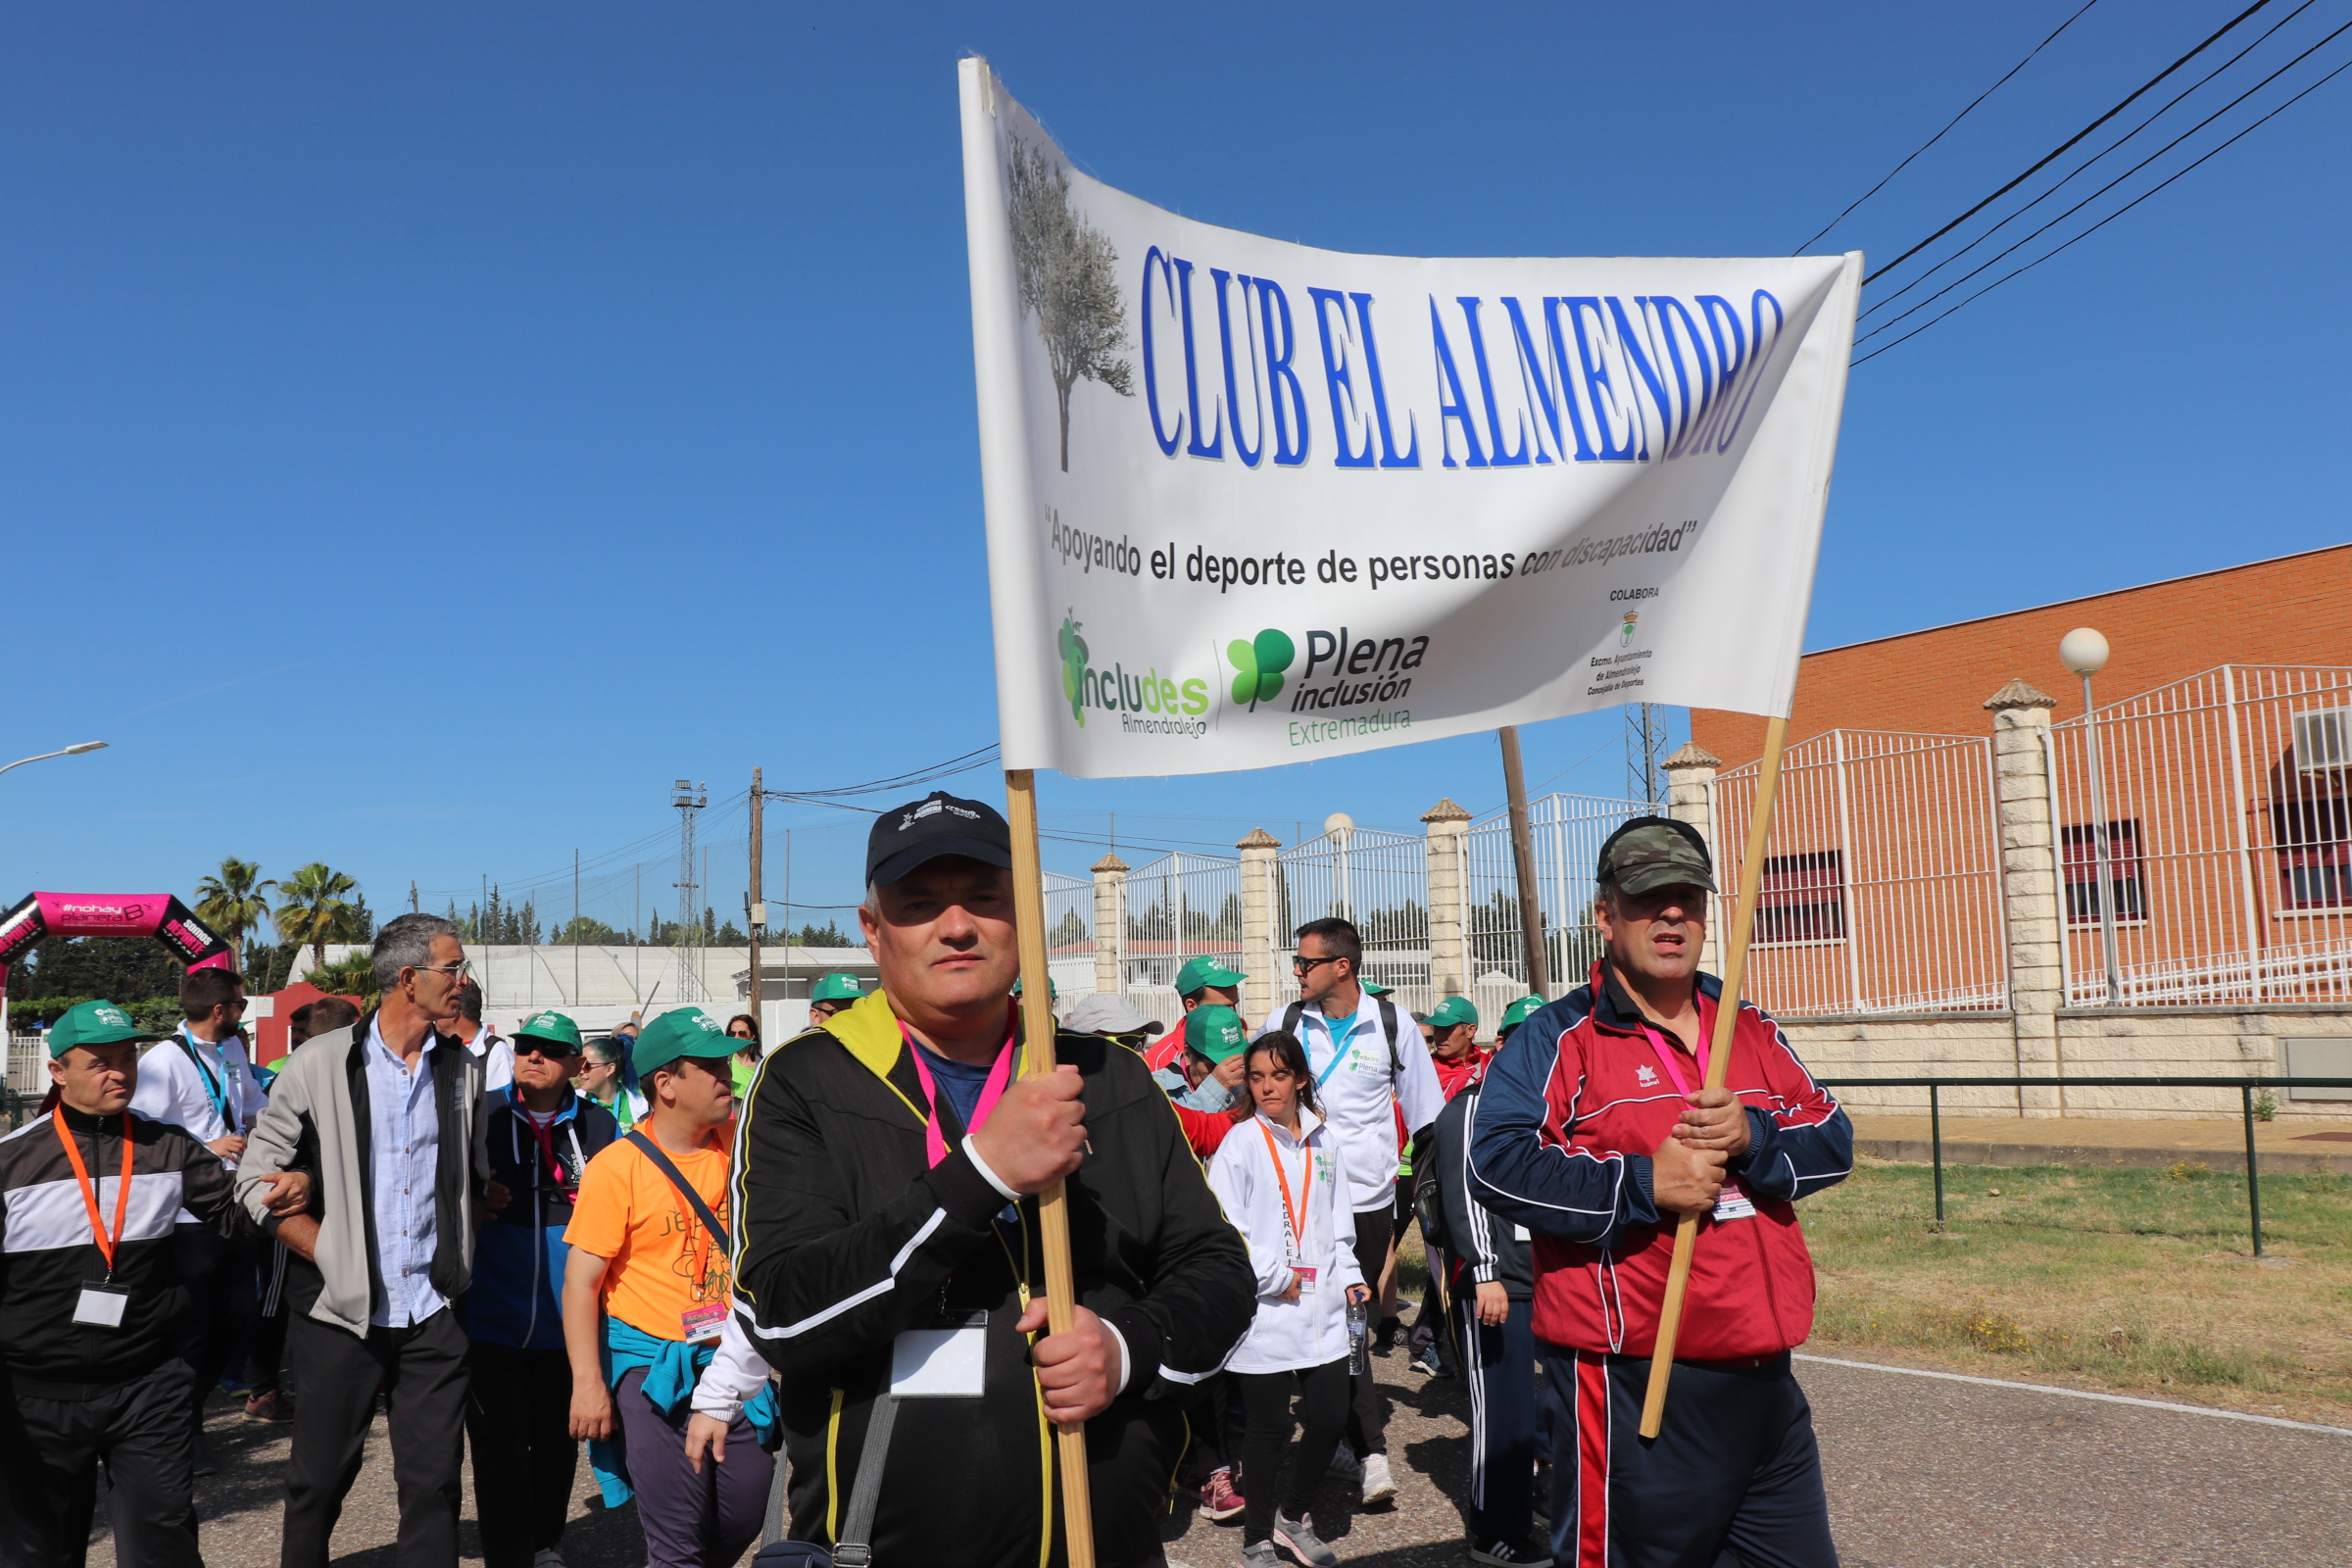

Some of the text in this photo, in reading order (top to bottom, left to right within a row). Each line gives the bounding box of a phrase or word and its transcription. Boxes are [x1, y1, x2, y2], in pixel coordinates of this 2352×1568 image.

[1142, 245, 1785, 470] CLUB EL ALMENDRO
[1151, 542, 1175, 580] el
[1186, 545, 1305, 594] deporte
[1317, 549, 1357, 584] de
[1368, 553, 1516, 591] personas
[1520, 549, 1563, 577] con
[1609, 587, 1660, 602] COLABORA
[1303, 626, 1430, 679] Plena
[1591, 649, 1652, 667] Excmo. Ayuntamiento
[1076, 654, 1209, 716] includes
[1596, 663, 1642, 682] de Almendralejo
[1614, 681, 1621, 691] de
[1621, 678, 1644, 689] Deportes
[1291, 671, 1412, 713] inclusión
[1121, 712, 1207, 740] Almendralejo
[1289, 709, 1411, 747] Extremadura
[61, 904, 144, 922] planeta B
[63, 904, 122, 914] #nohay
[166, 919, 207, 956] DEPORTE
[183, 919, 214, 946] SOMOS
[1358, 1062, 1378, 1072] Plena
[691, 1317, 719, 1329] DEPORTISTA
